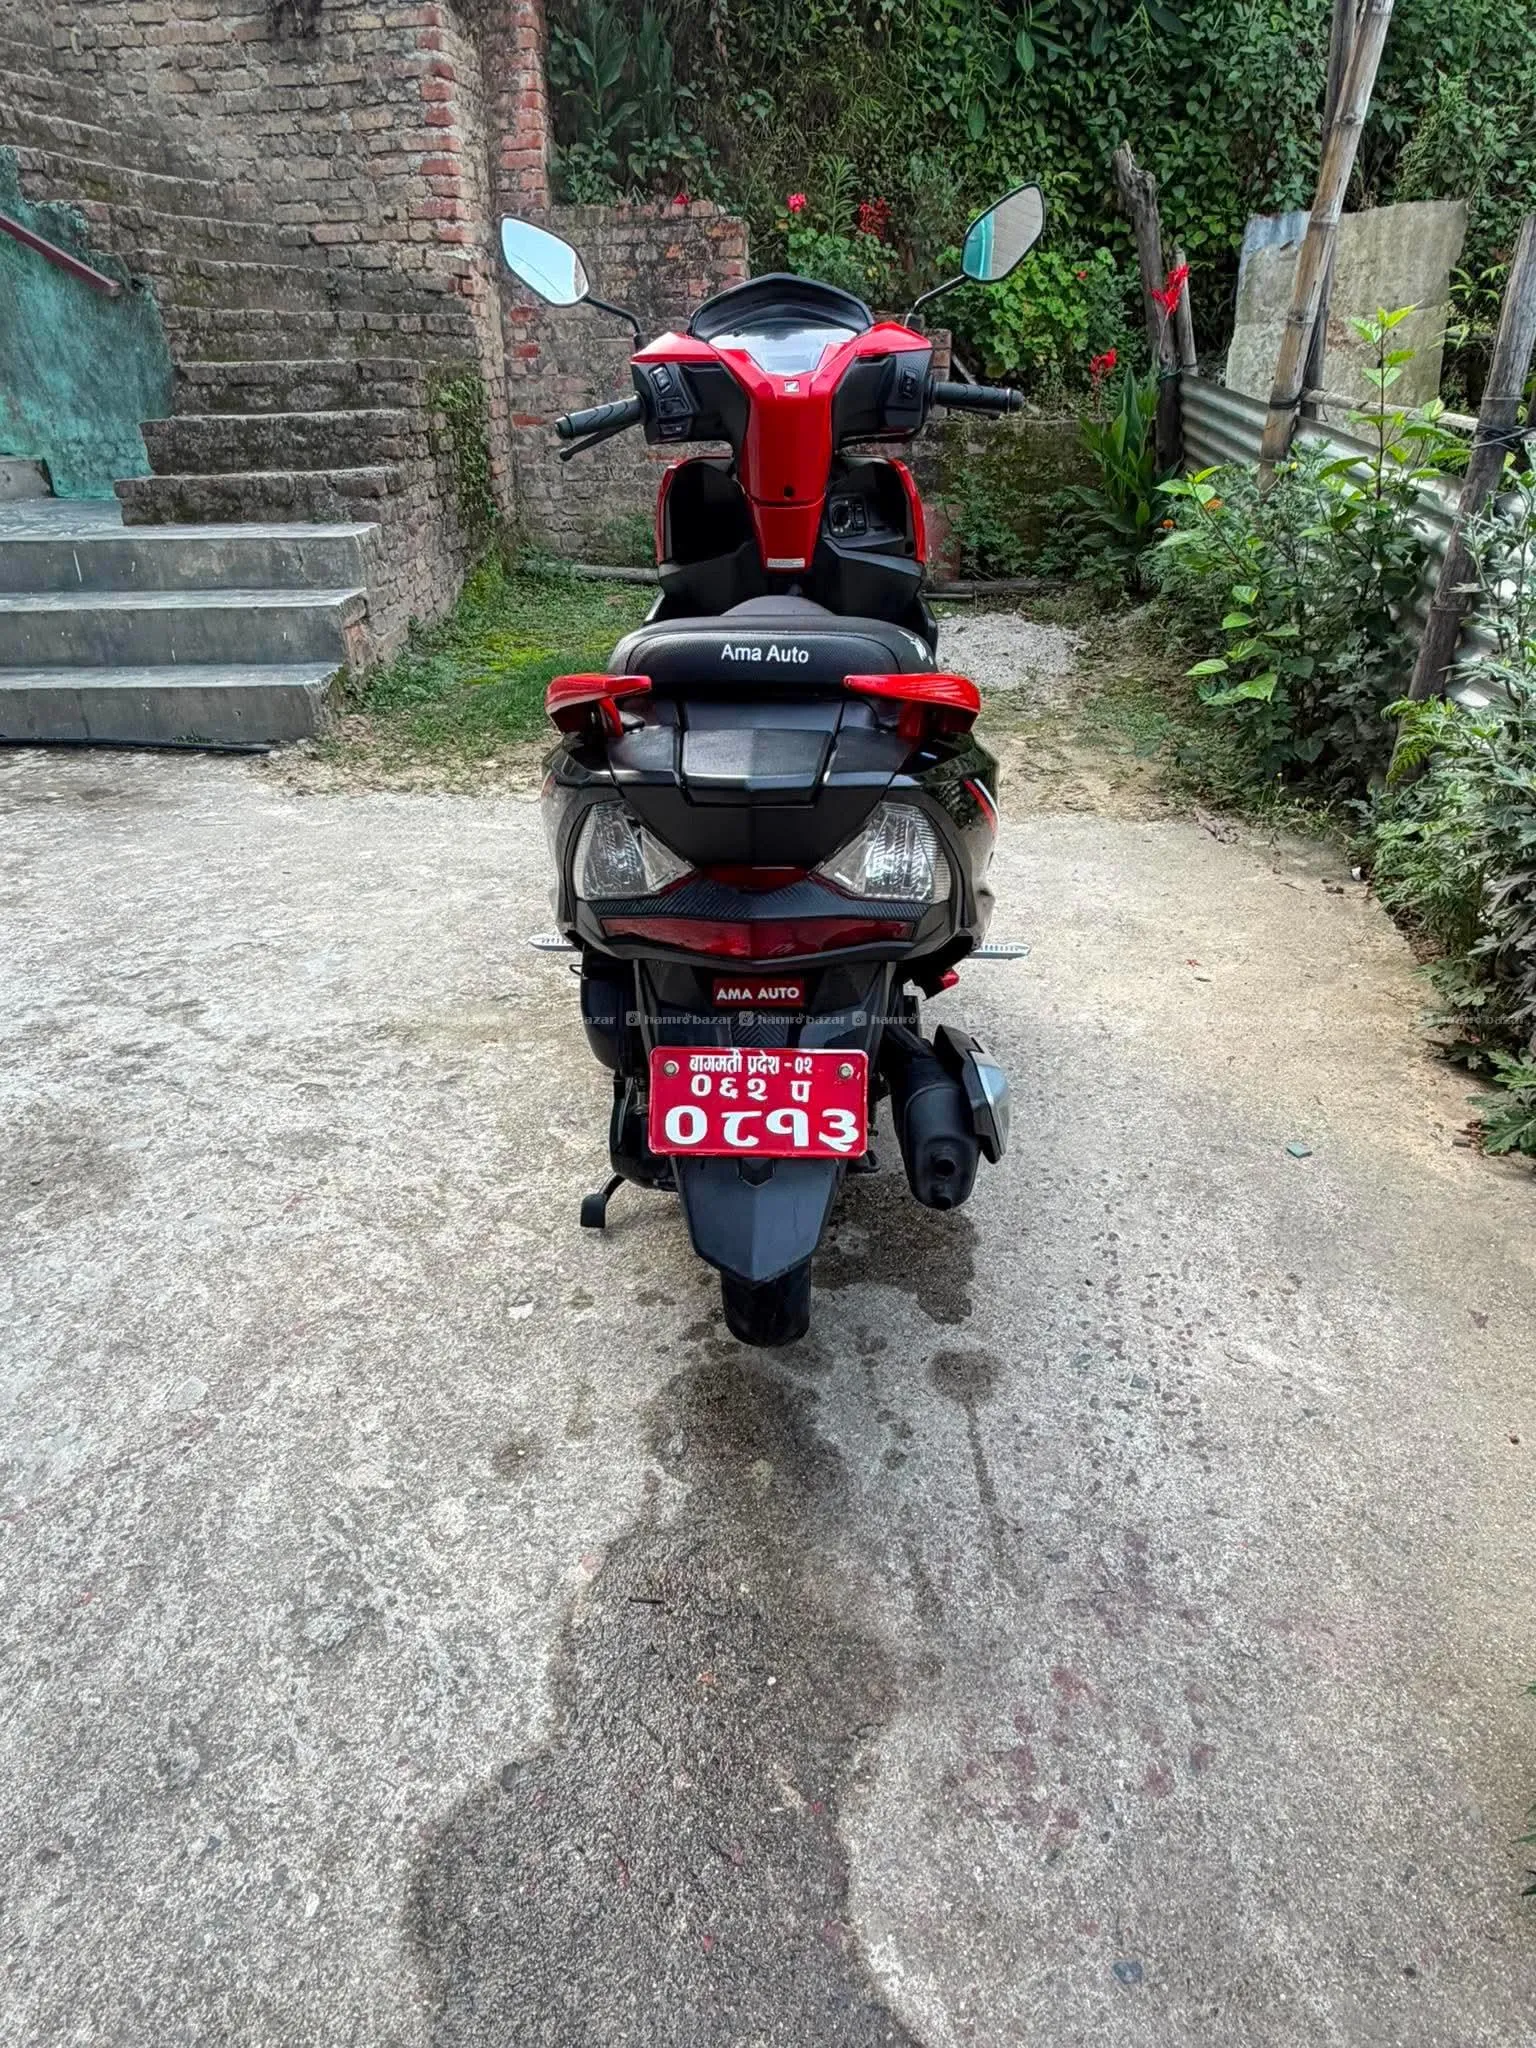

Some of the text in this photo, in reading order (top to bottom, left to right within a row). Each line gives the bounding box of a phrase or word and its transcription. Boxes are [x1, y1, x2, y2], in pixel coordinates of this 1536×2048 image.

[721, 644, 809, 664] Ama Auto
[716, 987, 800, 1000] AMA AUTO
[689, 1049, 743, 1073] बागमती
[747, 1051, 780, 1075] प्रदेश
[790, 1080, 812, 1102] प
[664, 1105, 859, 1151] ०८१३
